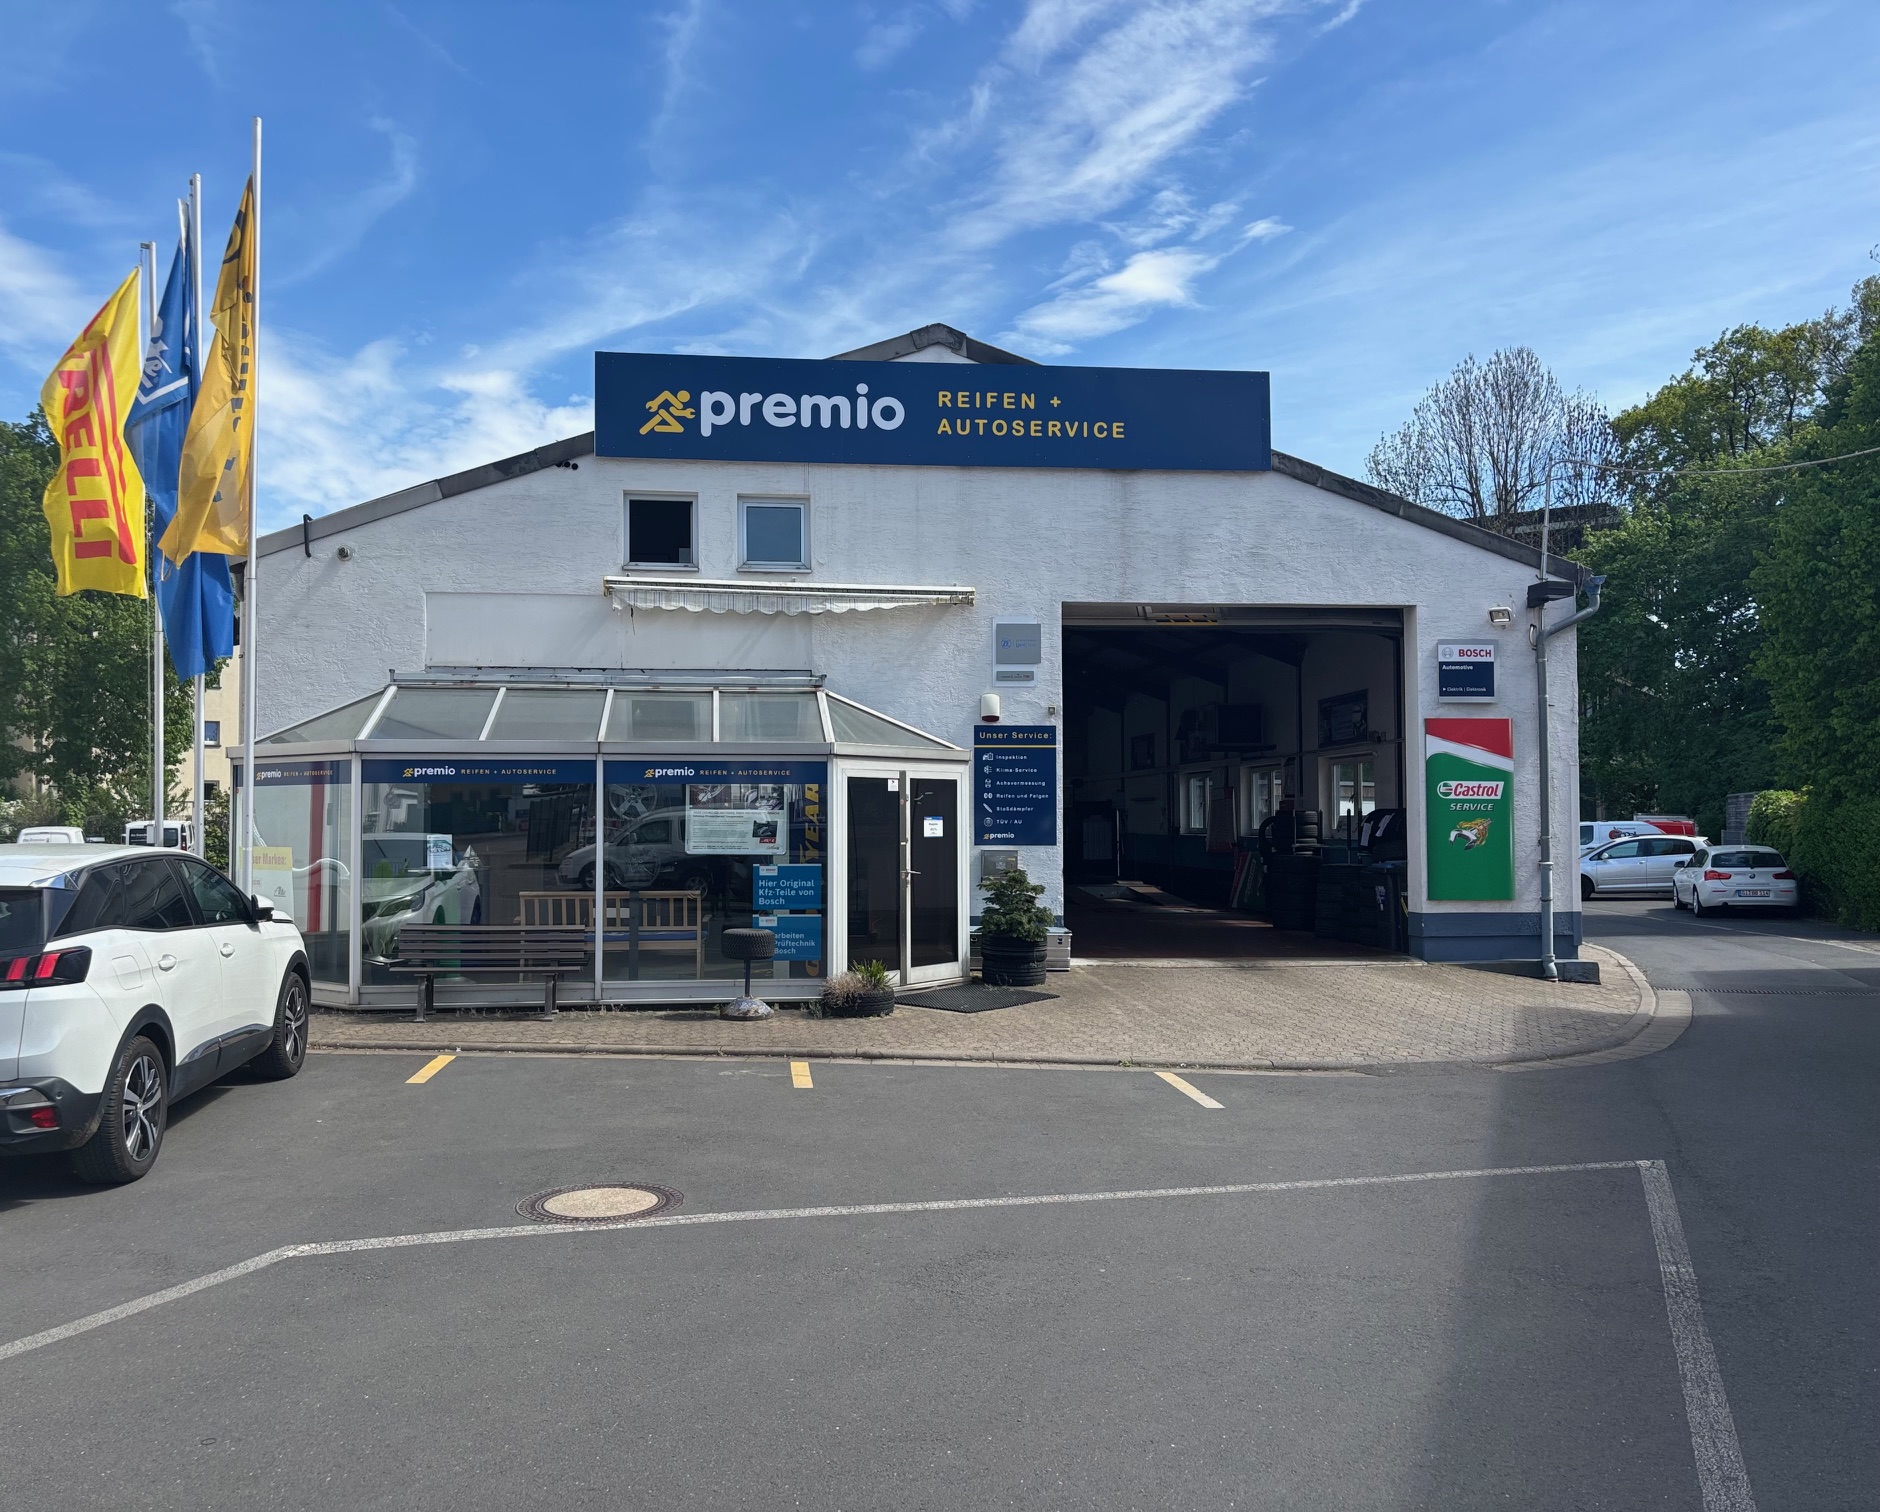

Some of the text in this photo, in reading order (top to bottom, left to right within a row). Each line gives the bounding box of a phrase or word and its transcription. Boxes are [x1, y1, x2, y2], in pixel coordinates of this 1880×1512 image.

[938, 391, 1035, 409] REIFEN
[701, 383, 905, 437] premio
[938, 418, 1125, 438] AUTOSERVICE
[1458, 648, 1492, 658] BOSCH
[262, 769, 282, 780] premio
[414, 766, 456, 777] premio
[655, 767, 694, 778] premio
[1454, 783, 1499, 796] Castrol
[262, 853, 286, 865] Marken:
[780, 880, 814, 888] Original
